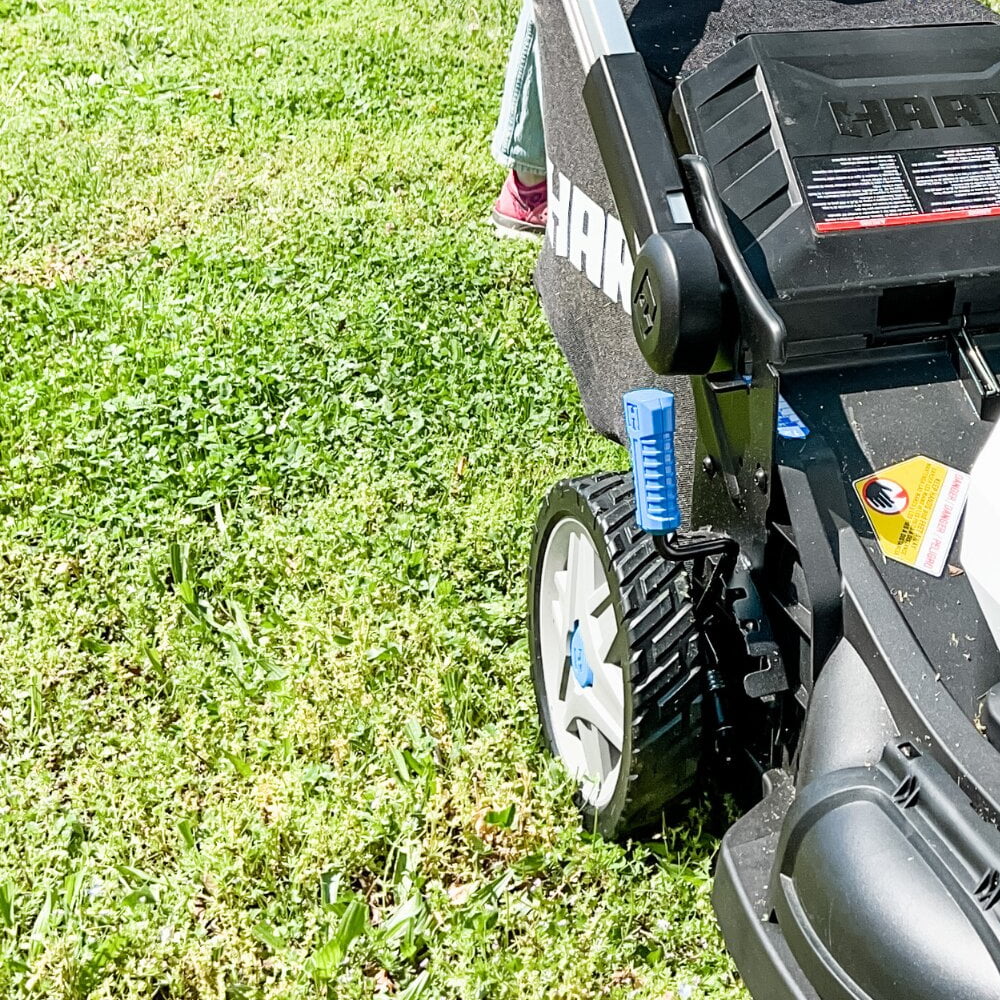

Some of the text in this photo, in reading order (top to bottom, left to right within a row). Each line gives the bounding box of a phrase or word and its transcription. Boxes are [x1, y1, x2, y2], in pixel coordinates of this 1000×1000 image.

[546, 156, 641, 316] HAR
[946, 473, 963, 502] DANGER
[935, 503, 953, 534] DANGER
